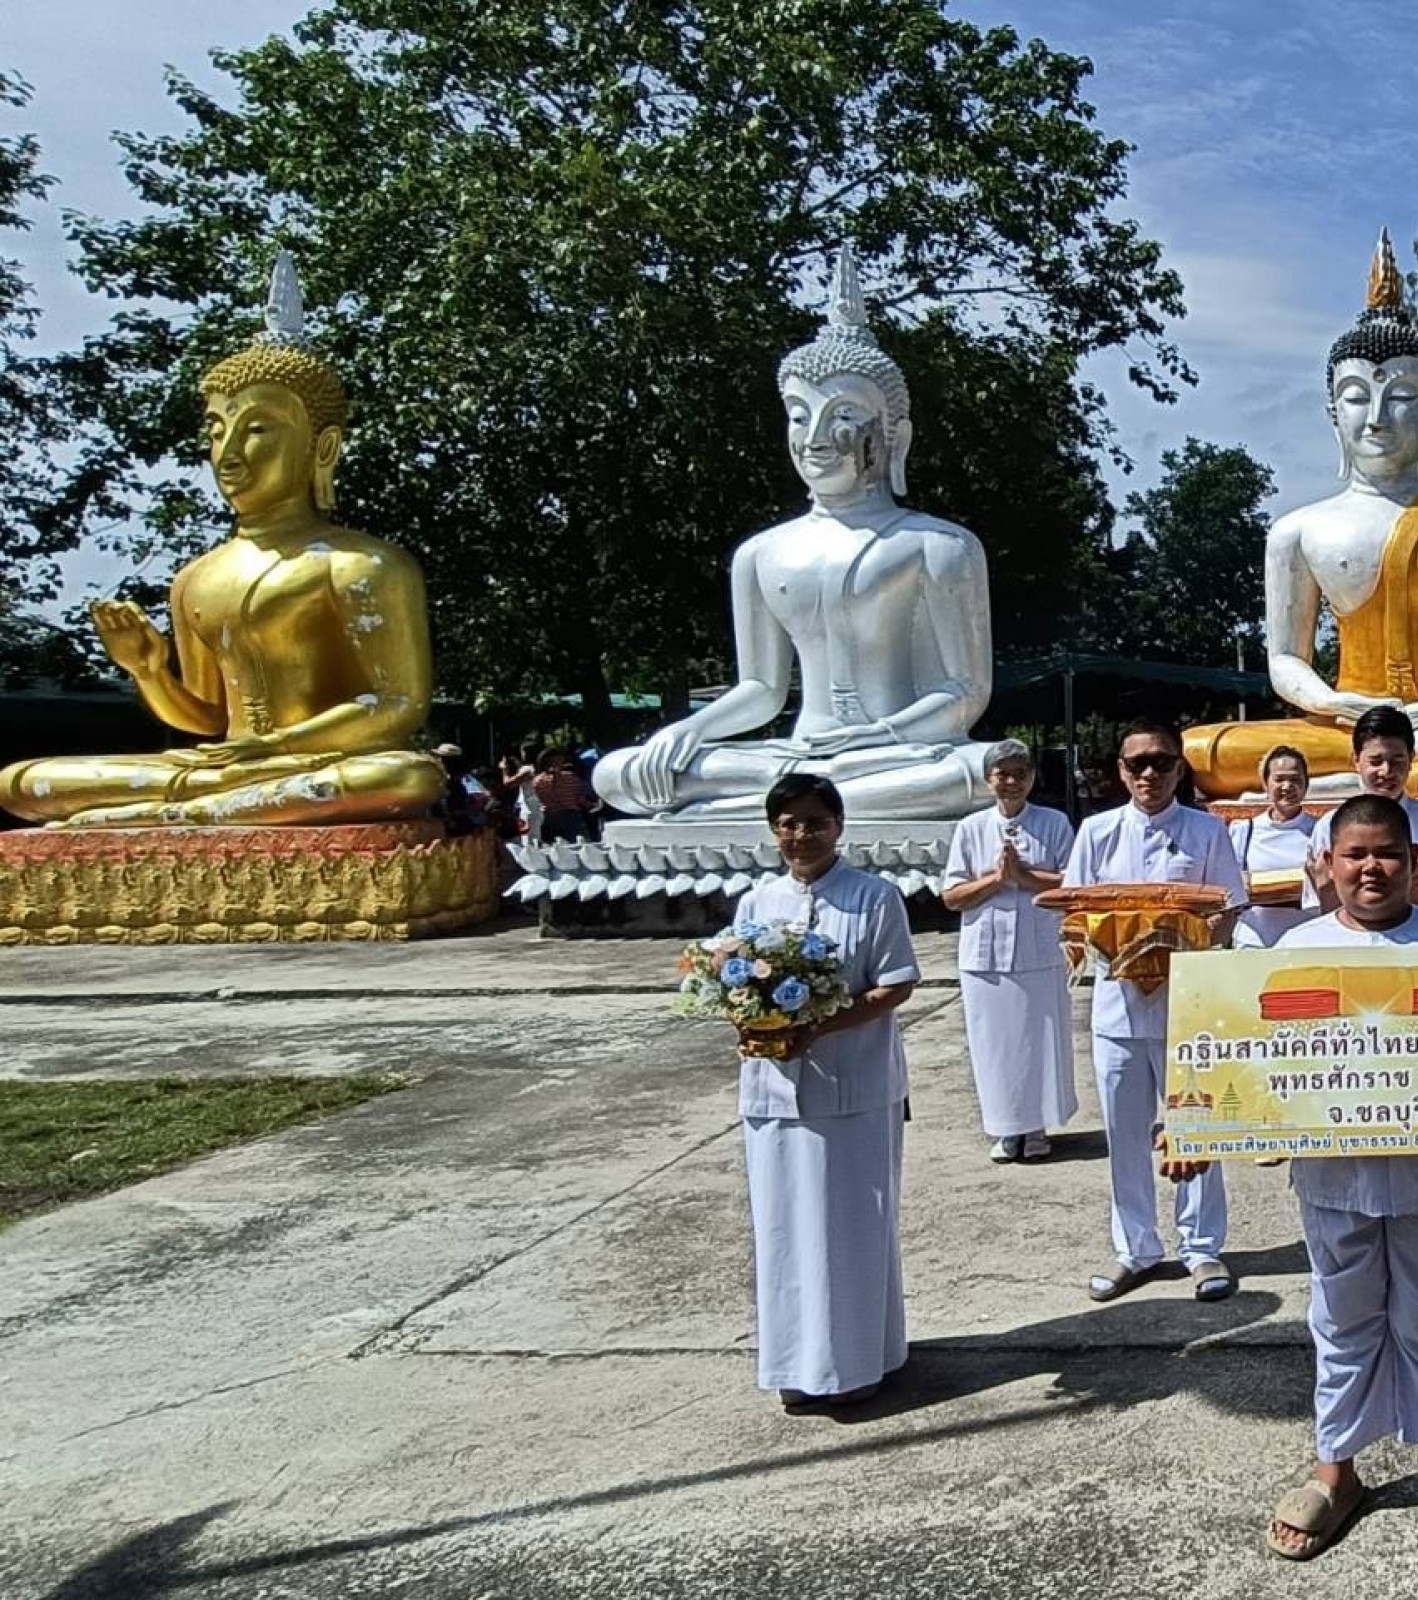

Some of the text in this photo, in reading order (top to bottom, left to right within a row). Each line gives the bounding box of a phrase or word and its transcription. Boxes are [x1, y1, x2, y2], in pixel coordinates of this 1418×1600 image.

[1269, 1064, 1411, 1099] พุทธศักราช
[1175, 1137, 1203, 1154] โดย
[1209, 1134, 1332, 1155] คณะศิษยานุศิษย์
